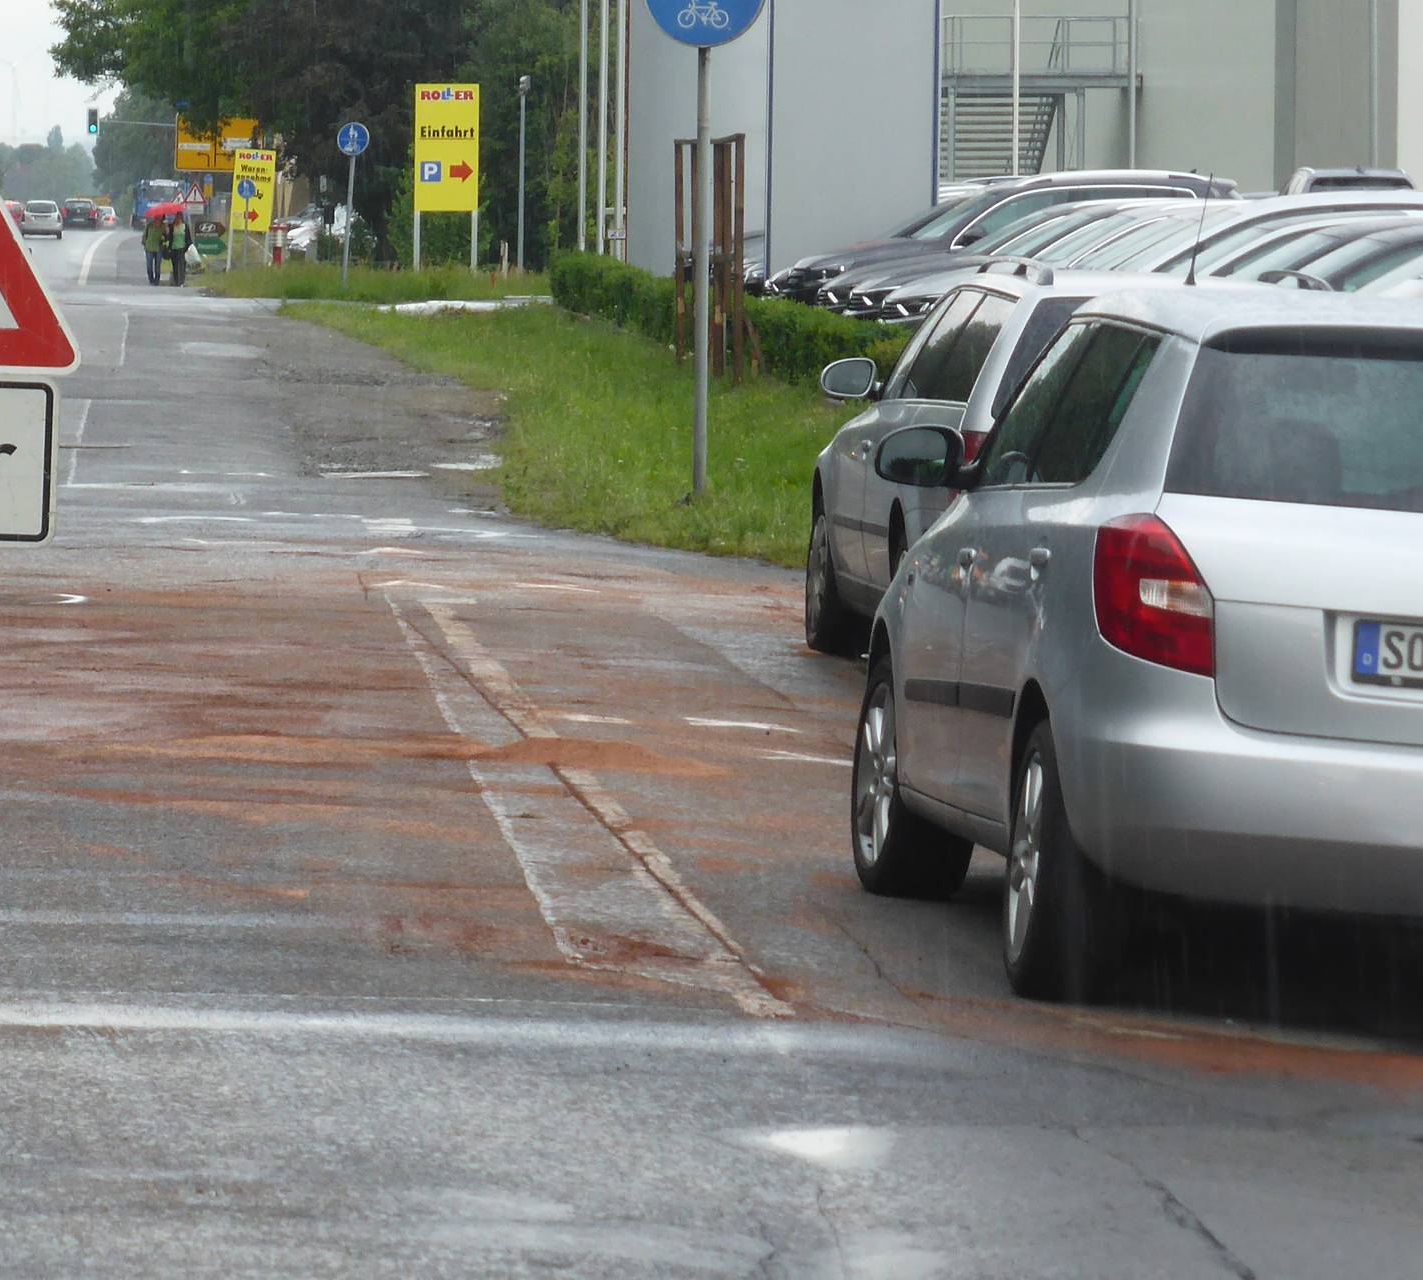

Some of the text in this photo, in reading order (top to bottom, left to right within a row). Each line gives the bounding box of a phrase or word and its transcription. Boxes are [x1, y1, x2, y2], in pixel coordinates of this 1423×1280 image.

[421, 87, 474, 101] ROLLER
[420, 125, 475, 138] Einfahrt
[423, 163, 438, 180] P
